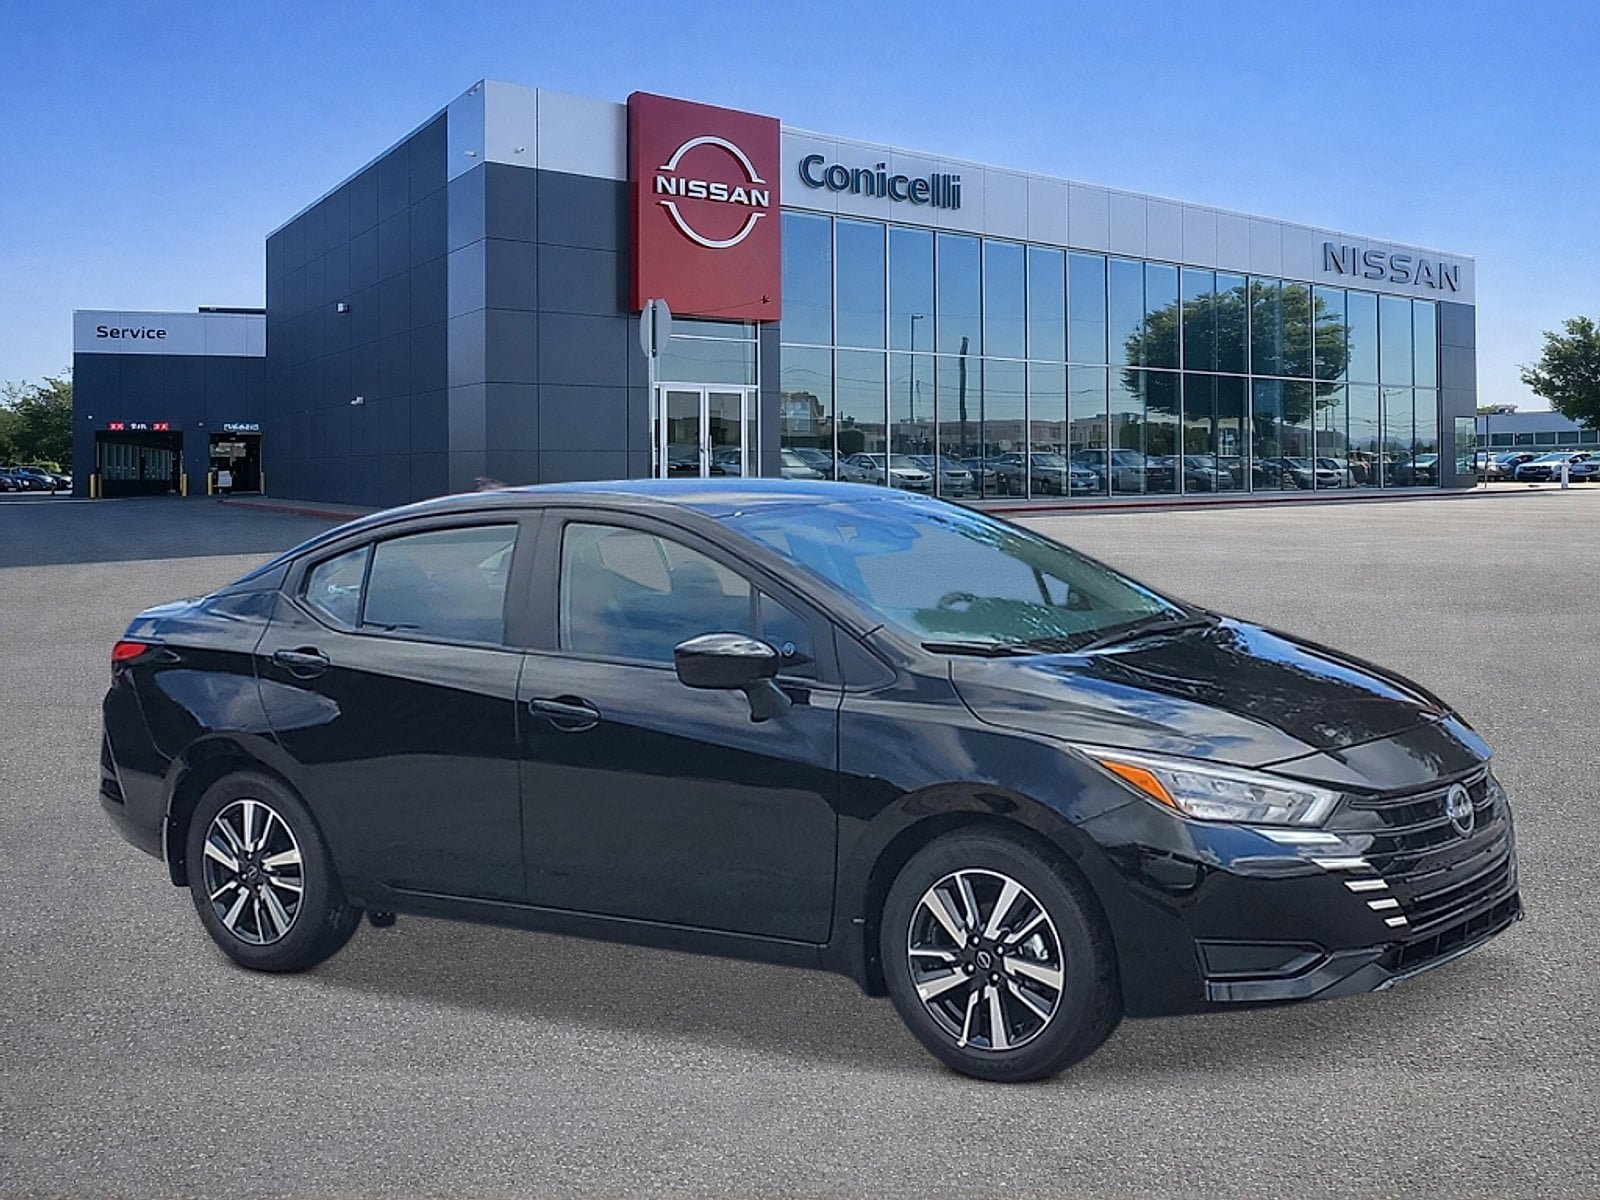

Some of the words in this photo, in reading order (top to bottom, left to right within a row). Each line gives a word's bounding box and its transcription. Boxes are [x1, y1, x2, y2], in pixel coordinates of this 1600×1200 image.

[655, 175, 769, 208] NISSAN
[799, 154, 961, 210] Conicelli
[1323, 242, 1461, 292] NISSAN
[96, 325, 167, 340] Service
